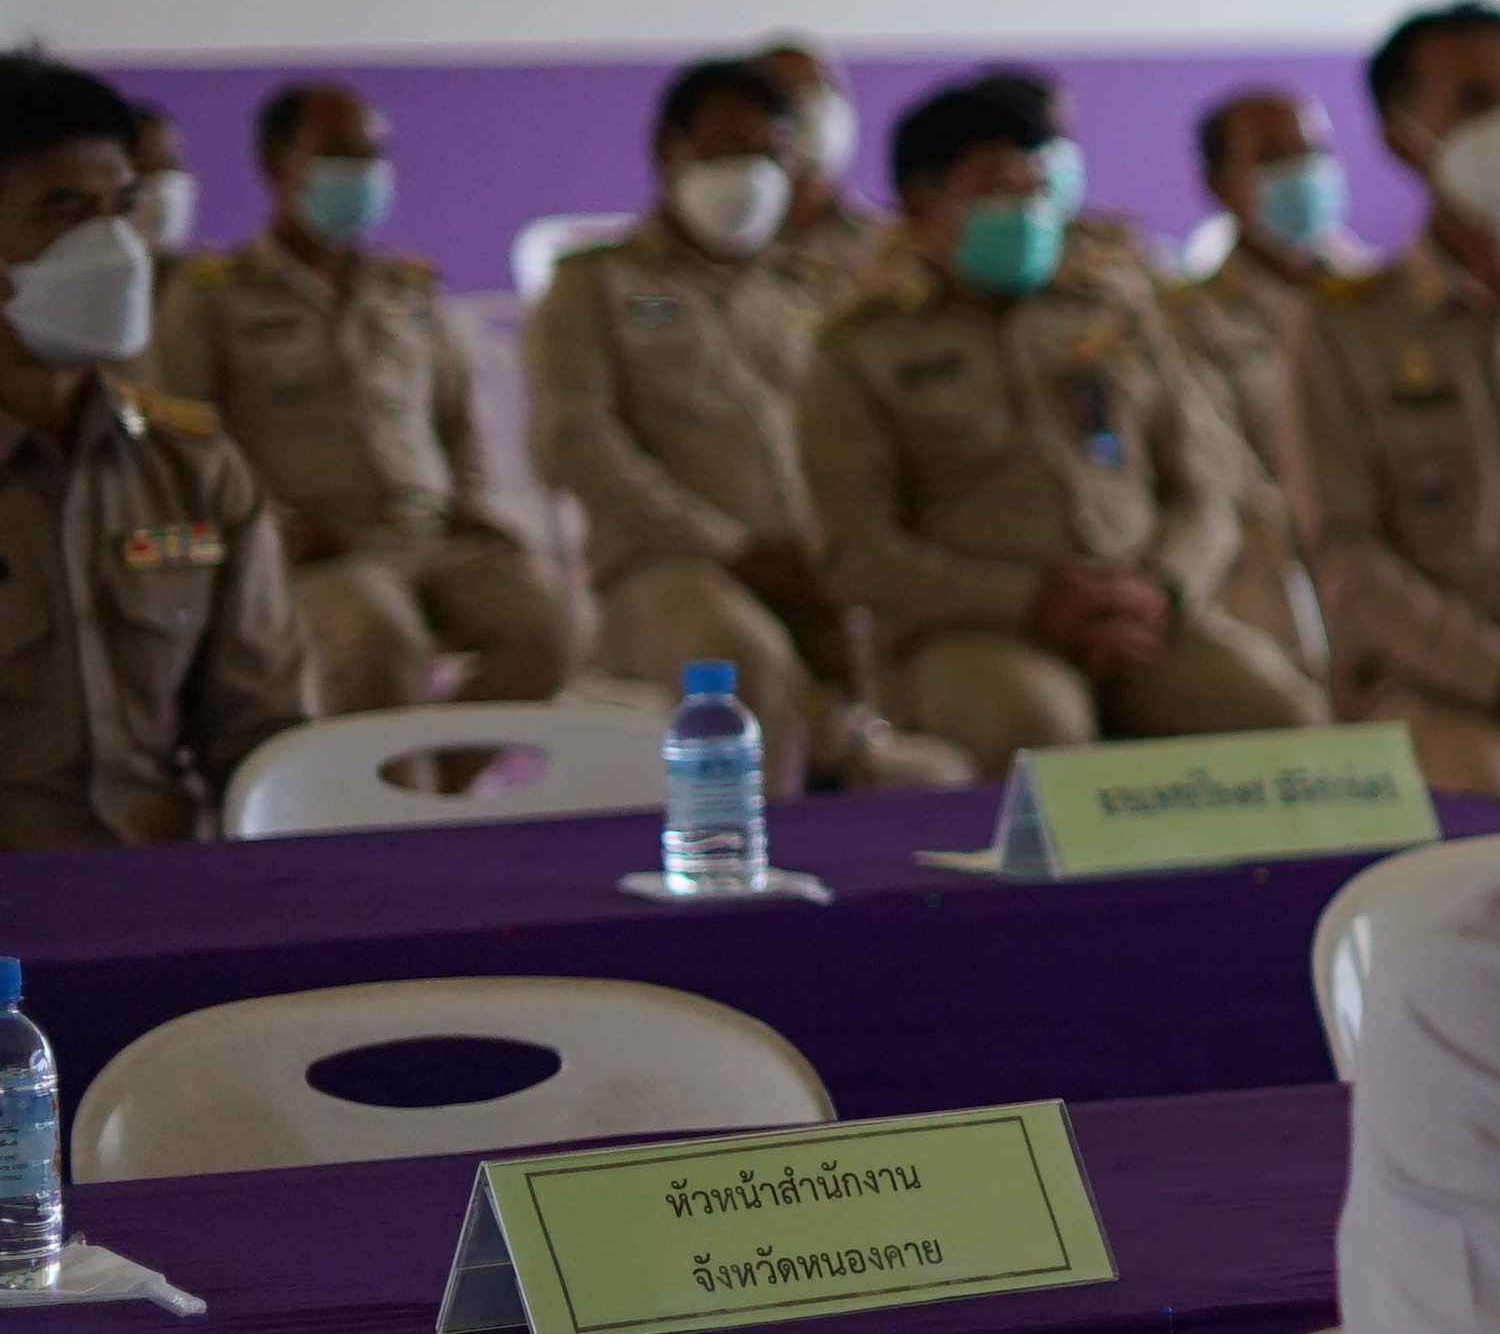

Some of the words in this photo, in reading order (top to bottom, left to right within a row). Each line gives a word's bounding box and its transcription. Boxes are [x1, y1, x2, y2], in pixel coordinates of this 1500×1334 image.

[665, 1159, 922, 1218] หัวหน้าสำนักงาน
[692, 1238, 943, 1292] จังหวัดหนองคาย
